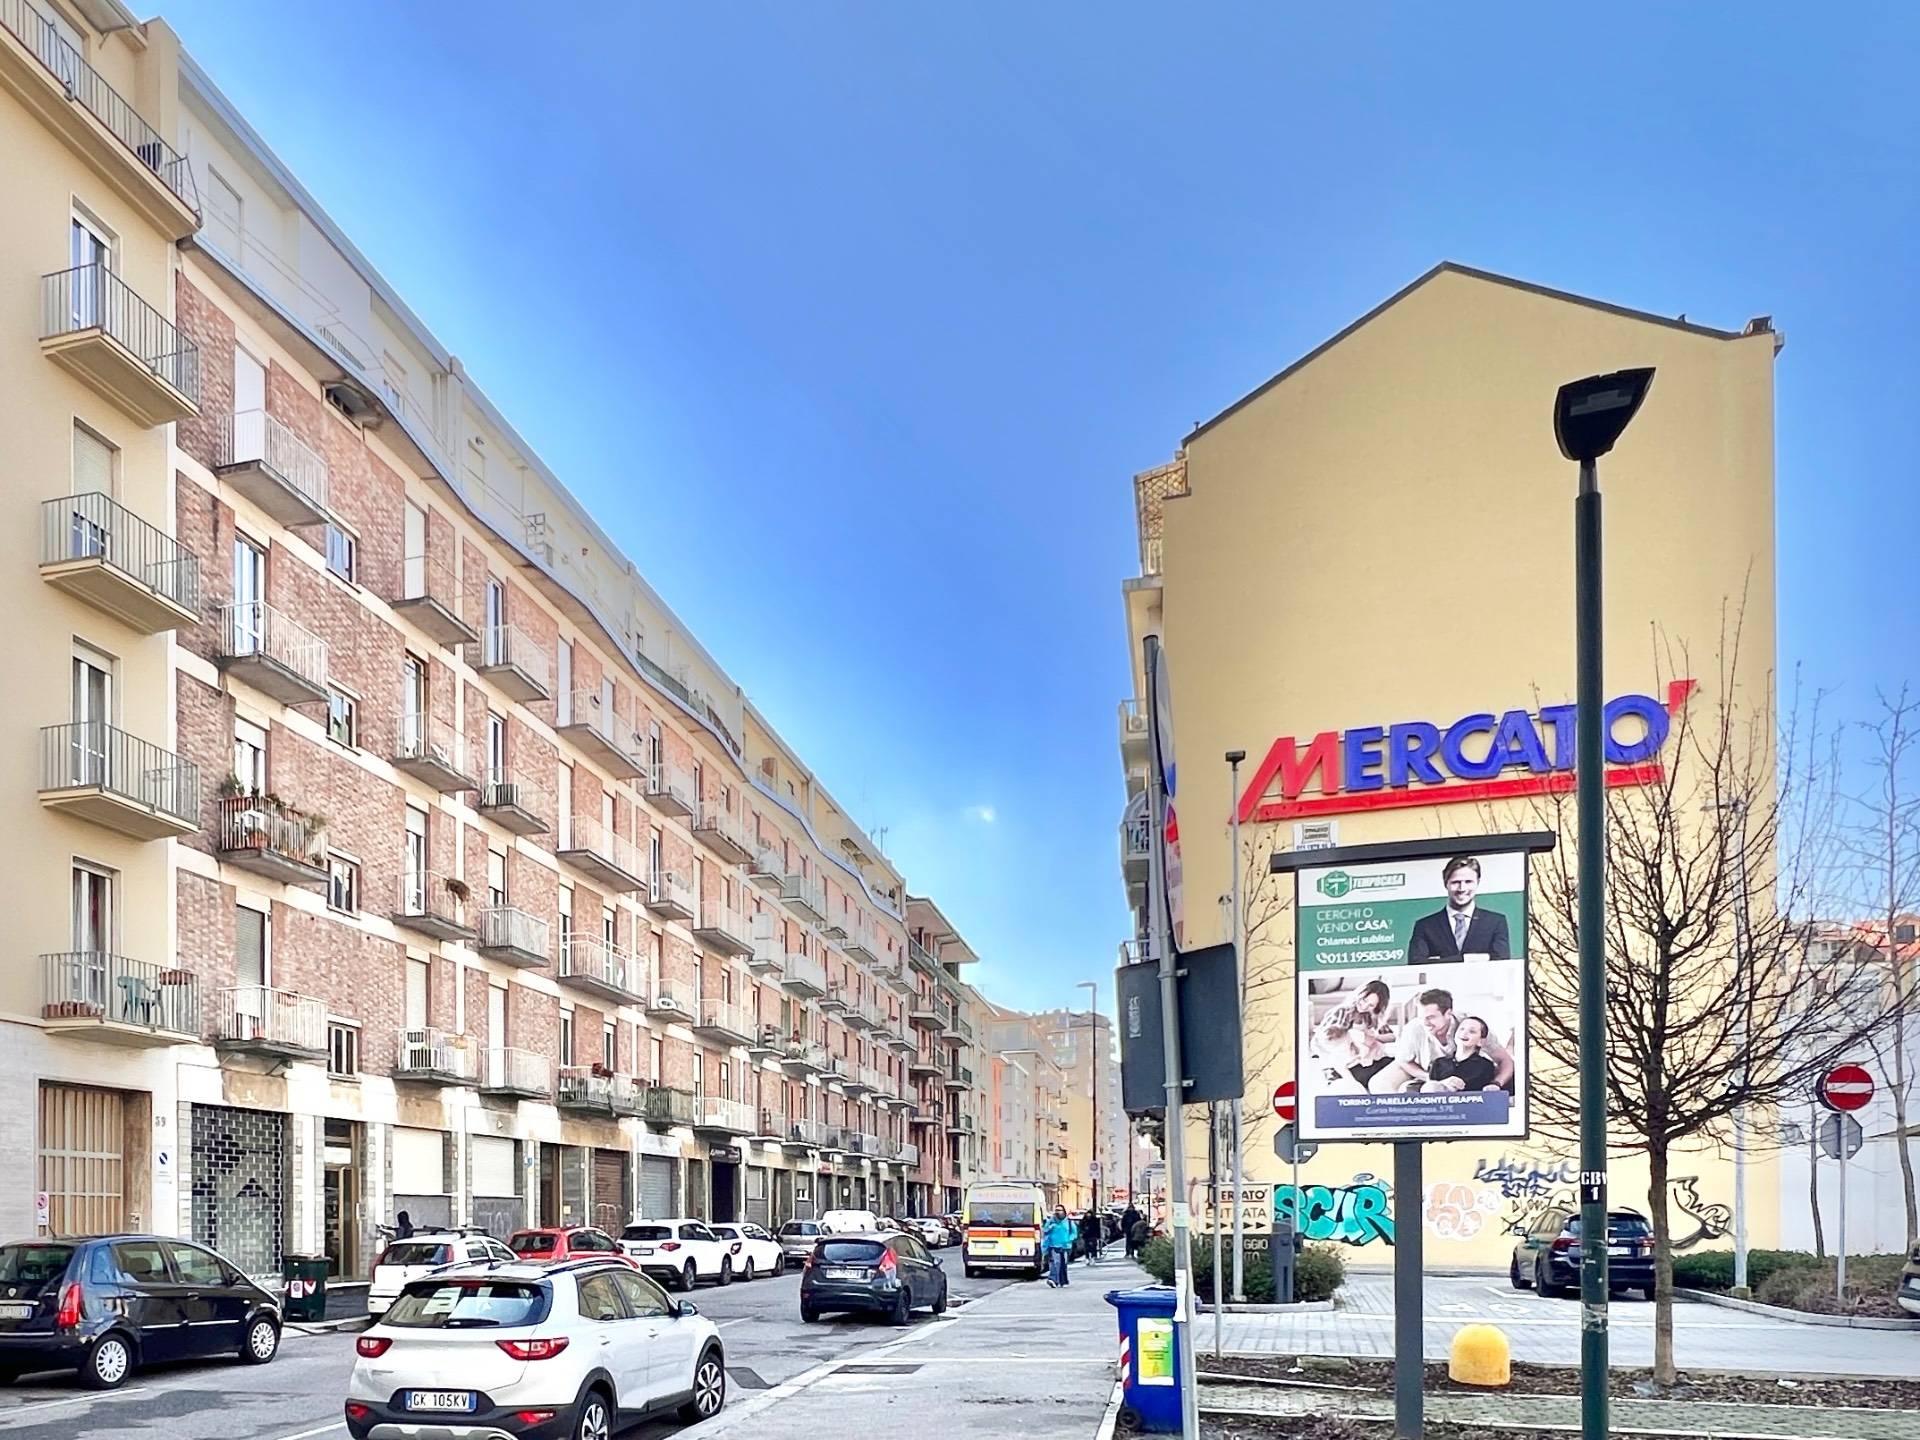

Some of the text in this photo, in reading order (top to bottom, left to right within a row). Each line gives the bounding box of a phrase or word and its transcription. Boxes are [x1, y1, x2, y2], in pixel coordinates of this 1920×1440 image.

[1316, 907, 1374, 921] CERCHI O
[1316, 922, 1354, 933] VENDI
[1316, 932, 1395, 947] Chiamaci subito!
[1327, 952, 1350, 963] 011
[1338, 1098, 1371, 1107] TORINO
[1448, 1095, 1484, 1104] GRAPPA
[1590, 1186, 1599, 1200] 1
[413, 1393, 468, 1407] GK 105KV
